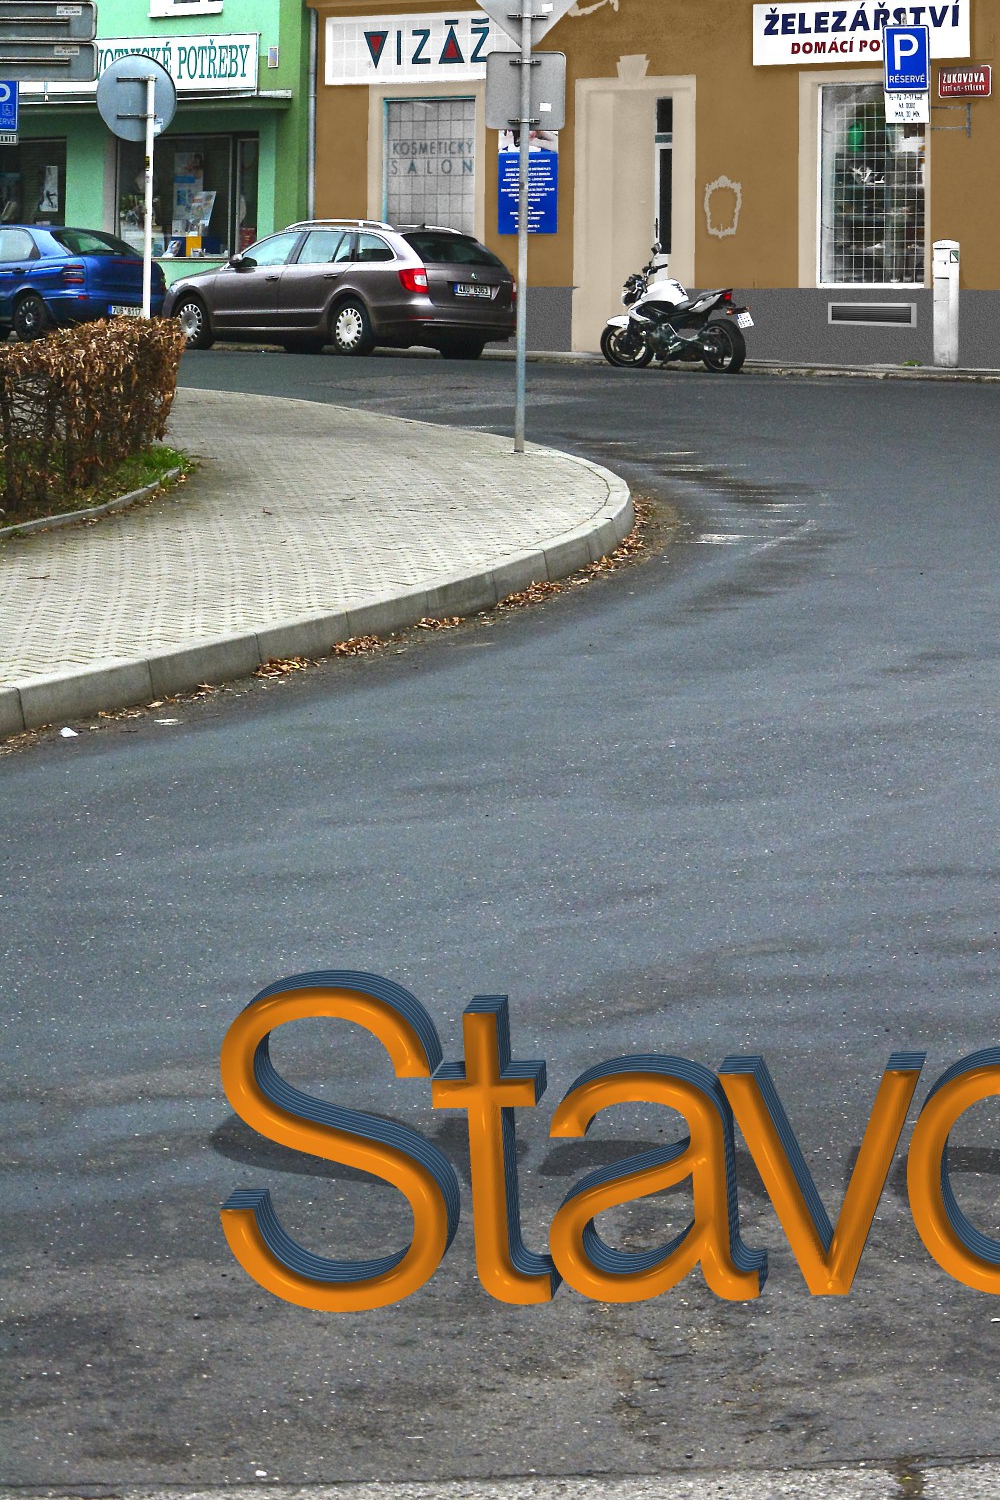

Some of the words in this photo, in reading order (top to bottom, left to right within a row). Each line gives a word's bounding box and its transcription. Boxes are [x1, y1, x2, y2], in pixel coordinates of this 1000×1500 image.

[363, 17, 490, 69] VIZÁŽ
[790, 37, 854, 55] DOMÁCÍ
[894, 33, 920, 71] P
[177, 38, 250, 79] POTŘEBY
[889, 74, 926, 83] RÉSERVÉ
[392, 139, 473, 156] KOSMETICKÝ
[390, 159, 473, 175] SALON
